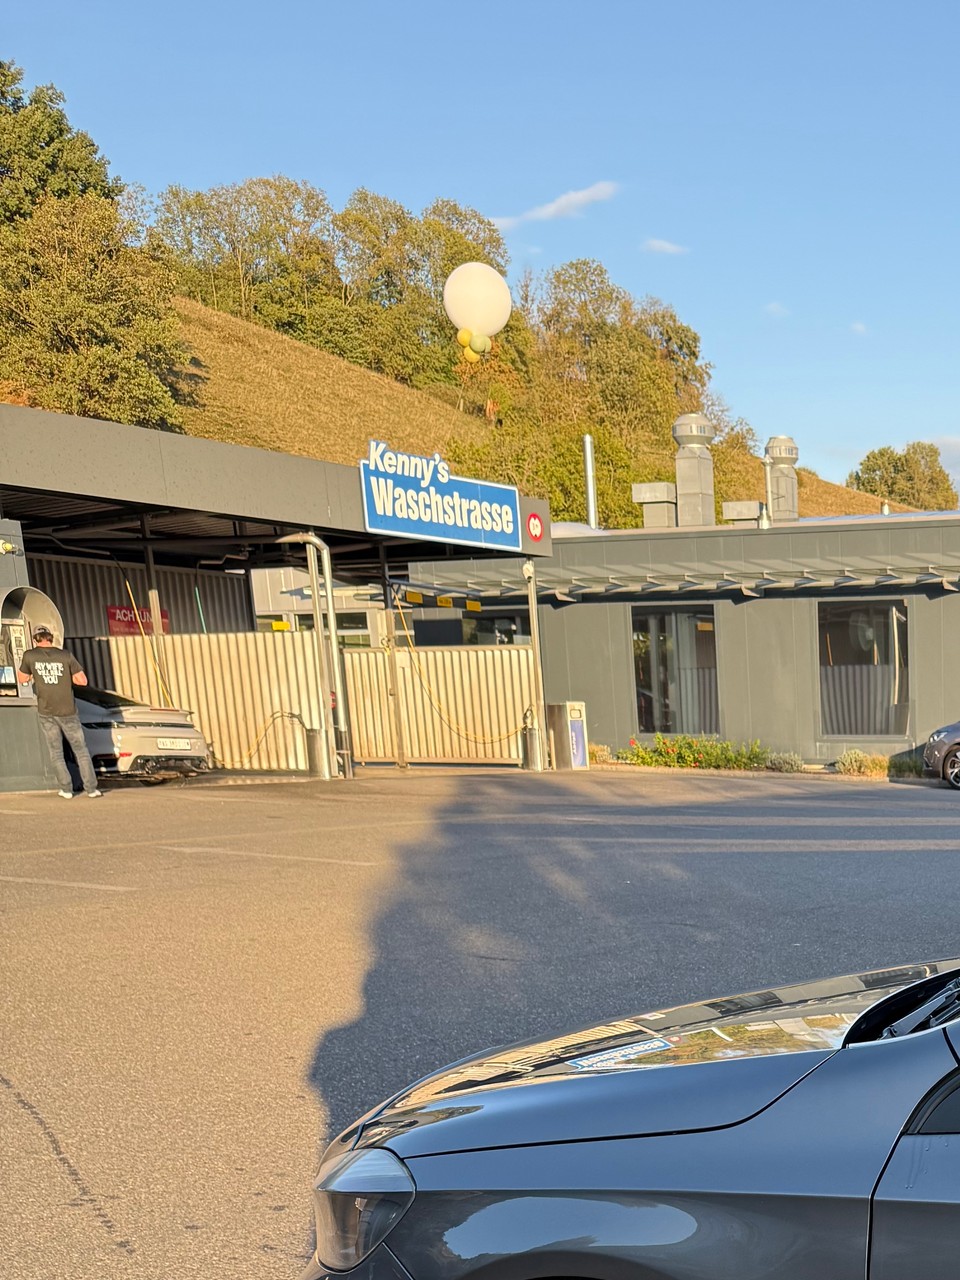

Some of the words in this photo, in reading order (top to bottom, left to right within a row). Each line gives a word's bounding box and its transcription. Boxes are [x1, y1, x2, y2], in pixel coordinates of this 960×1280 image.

[369, 440, 450, 488] Kenny's
[369, 475, 515, 535] Waschstrasse
[115, 609, 154, 623] ACHUN
[42, 675, 59, 684] YOU
